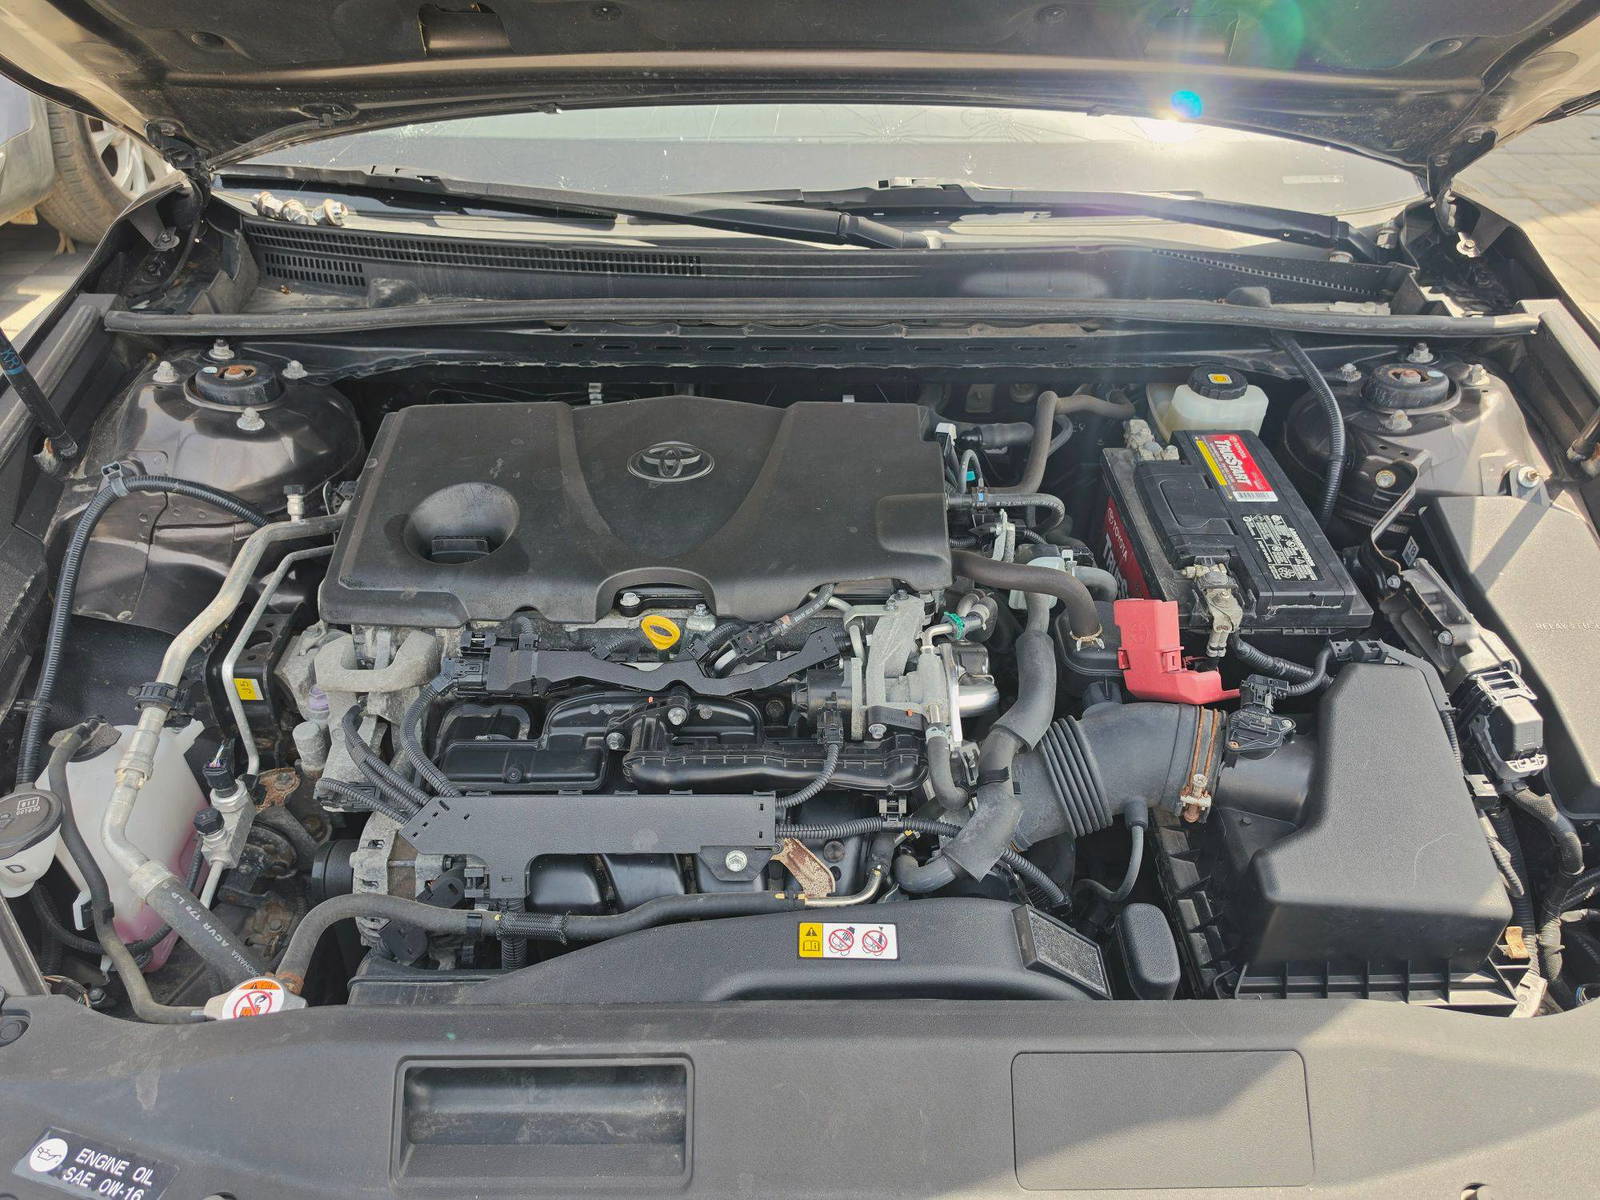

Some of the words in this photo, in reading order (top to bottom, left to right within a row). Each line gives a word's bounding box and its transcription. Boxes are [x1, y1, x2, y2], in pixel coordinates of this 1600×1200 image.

[1111, 519, 1128, 562] TOYOTA
[203, 922, 230, 947] ACVR
[63, 1166, 96, 1188] SAE
[75, 1147, 130, 1176] ENGINE
[132, 1166, 153, 1185] OIL
